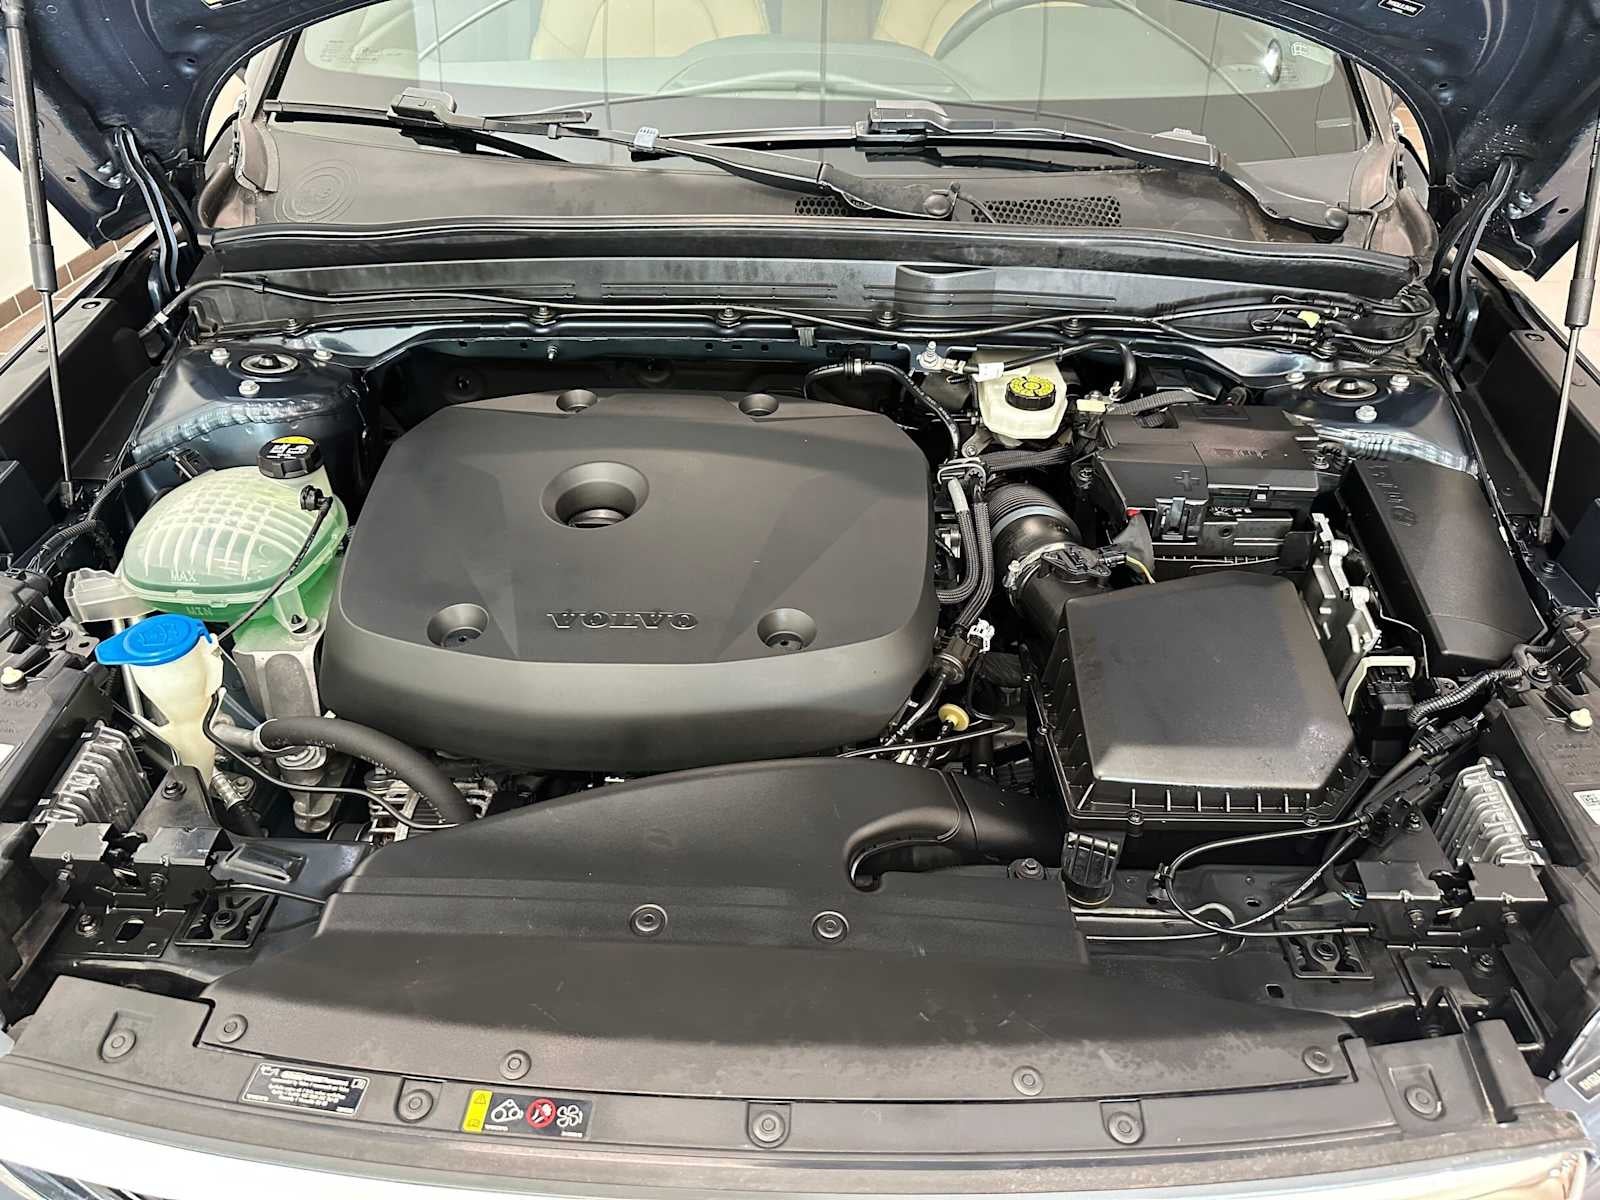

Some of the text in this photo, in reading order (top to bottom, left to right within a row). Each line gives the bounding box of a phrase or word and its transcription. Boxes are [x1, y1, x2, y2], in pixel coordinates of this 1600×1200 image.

[170, 570, 197, 582] MAX
[185, 605, 214, 616] MIN
[546, 611, 698, 630] VOLVO
